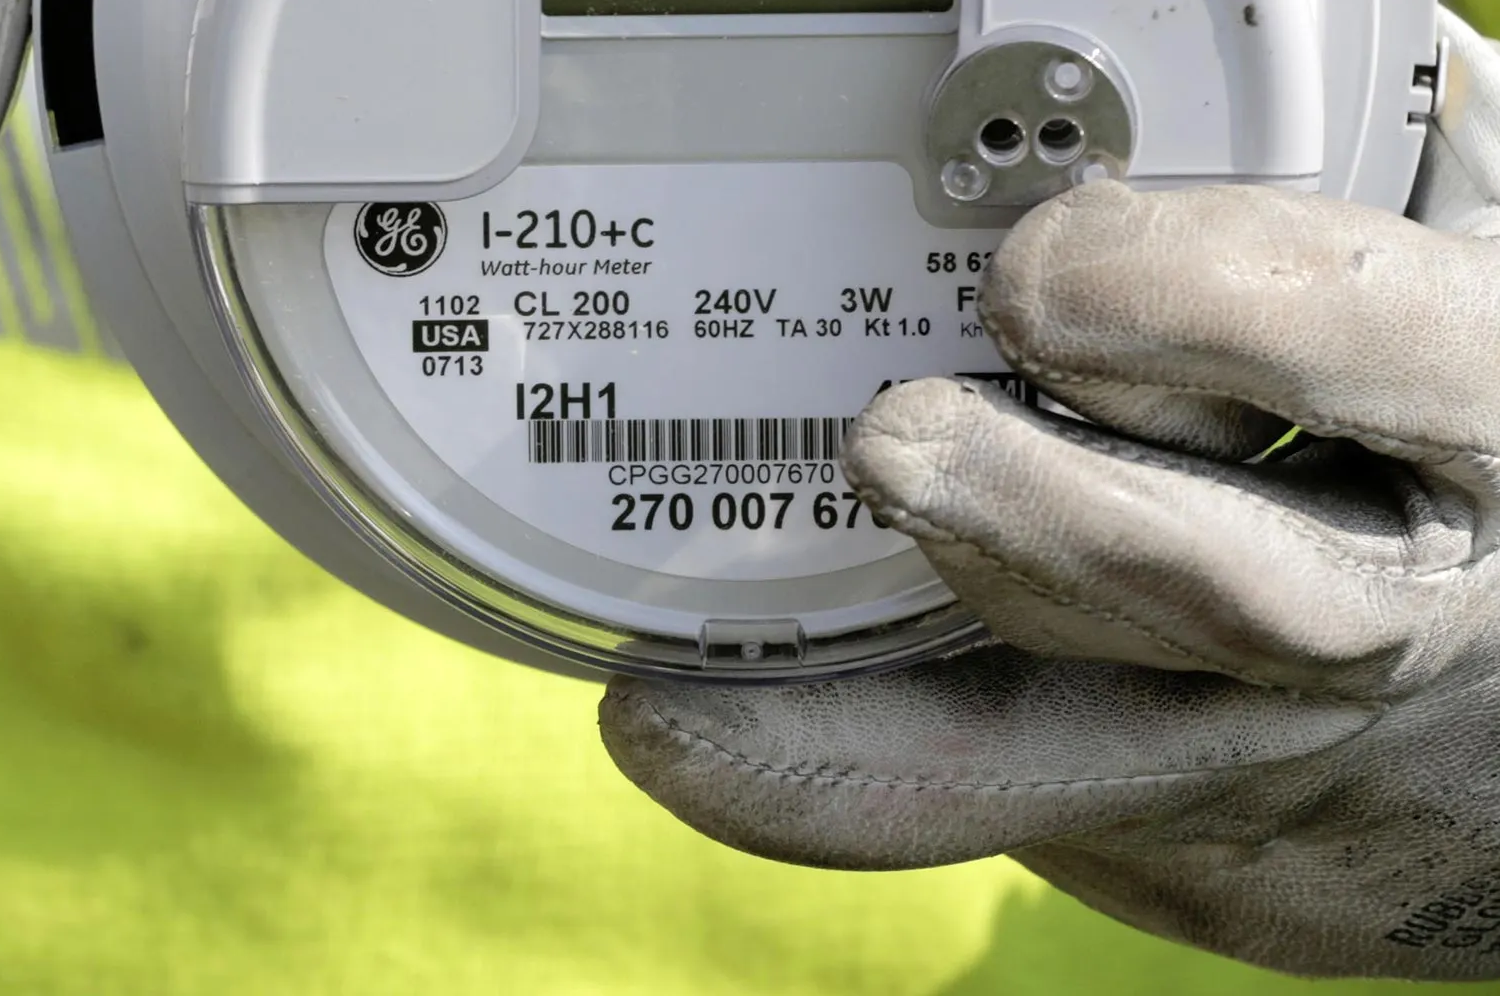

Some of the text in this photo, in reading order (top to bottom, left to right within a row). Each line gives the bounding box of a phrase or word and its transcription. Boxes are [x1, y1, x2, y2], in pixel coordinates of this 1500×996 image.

[481, 257, 653, 277] Watt-hour Meter
[926, 251, 957, 274] 58
[419, 294, 480, 316] 1102
[513, 290, 561, 317] CL
[572, 290, 630, 317] 200
[694, 288, 777, 315] 240V
[840, 287, 893, 314] 3W
[421, 324, 482, 347] USA
[523, 316, 983, 341] 727X288116 60HZ TA 30 Kt 1.0 Kh
[421, 354, 484, 377] 0713
[516, 381, 617, 420] I2H1
[608, 462, 835, 487] CPGG270007670
[611, 492, 694, 531] 270
[711, 491, 795, 531] 007
